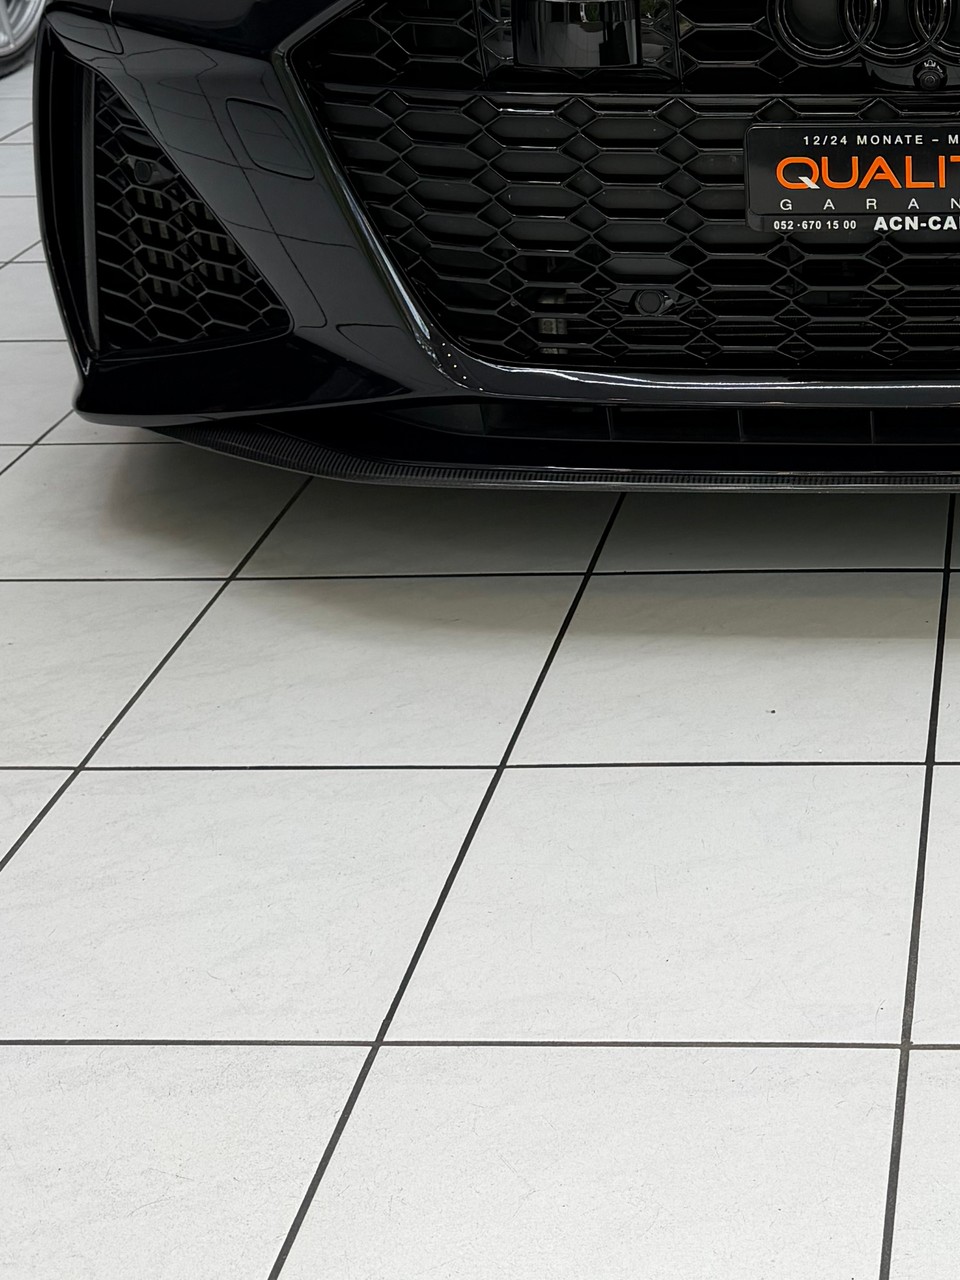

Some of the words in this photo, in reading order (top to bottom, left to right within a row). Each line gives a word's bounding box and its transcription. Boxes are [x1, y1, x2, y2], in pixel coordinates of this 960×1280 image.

[802, 134, 849, 146] 12/24
[856, 134, 924, 146] MONATE
[825, 220, 839, 231] 15
[843, 220, 857, 231] 00
